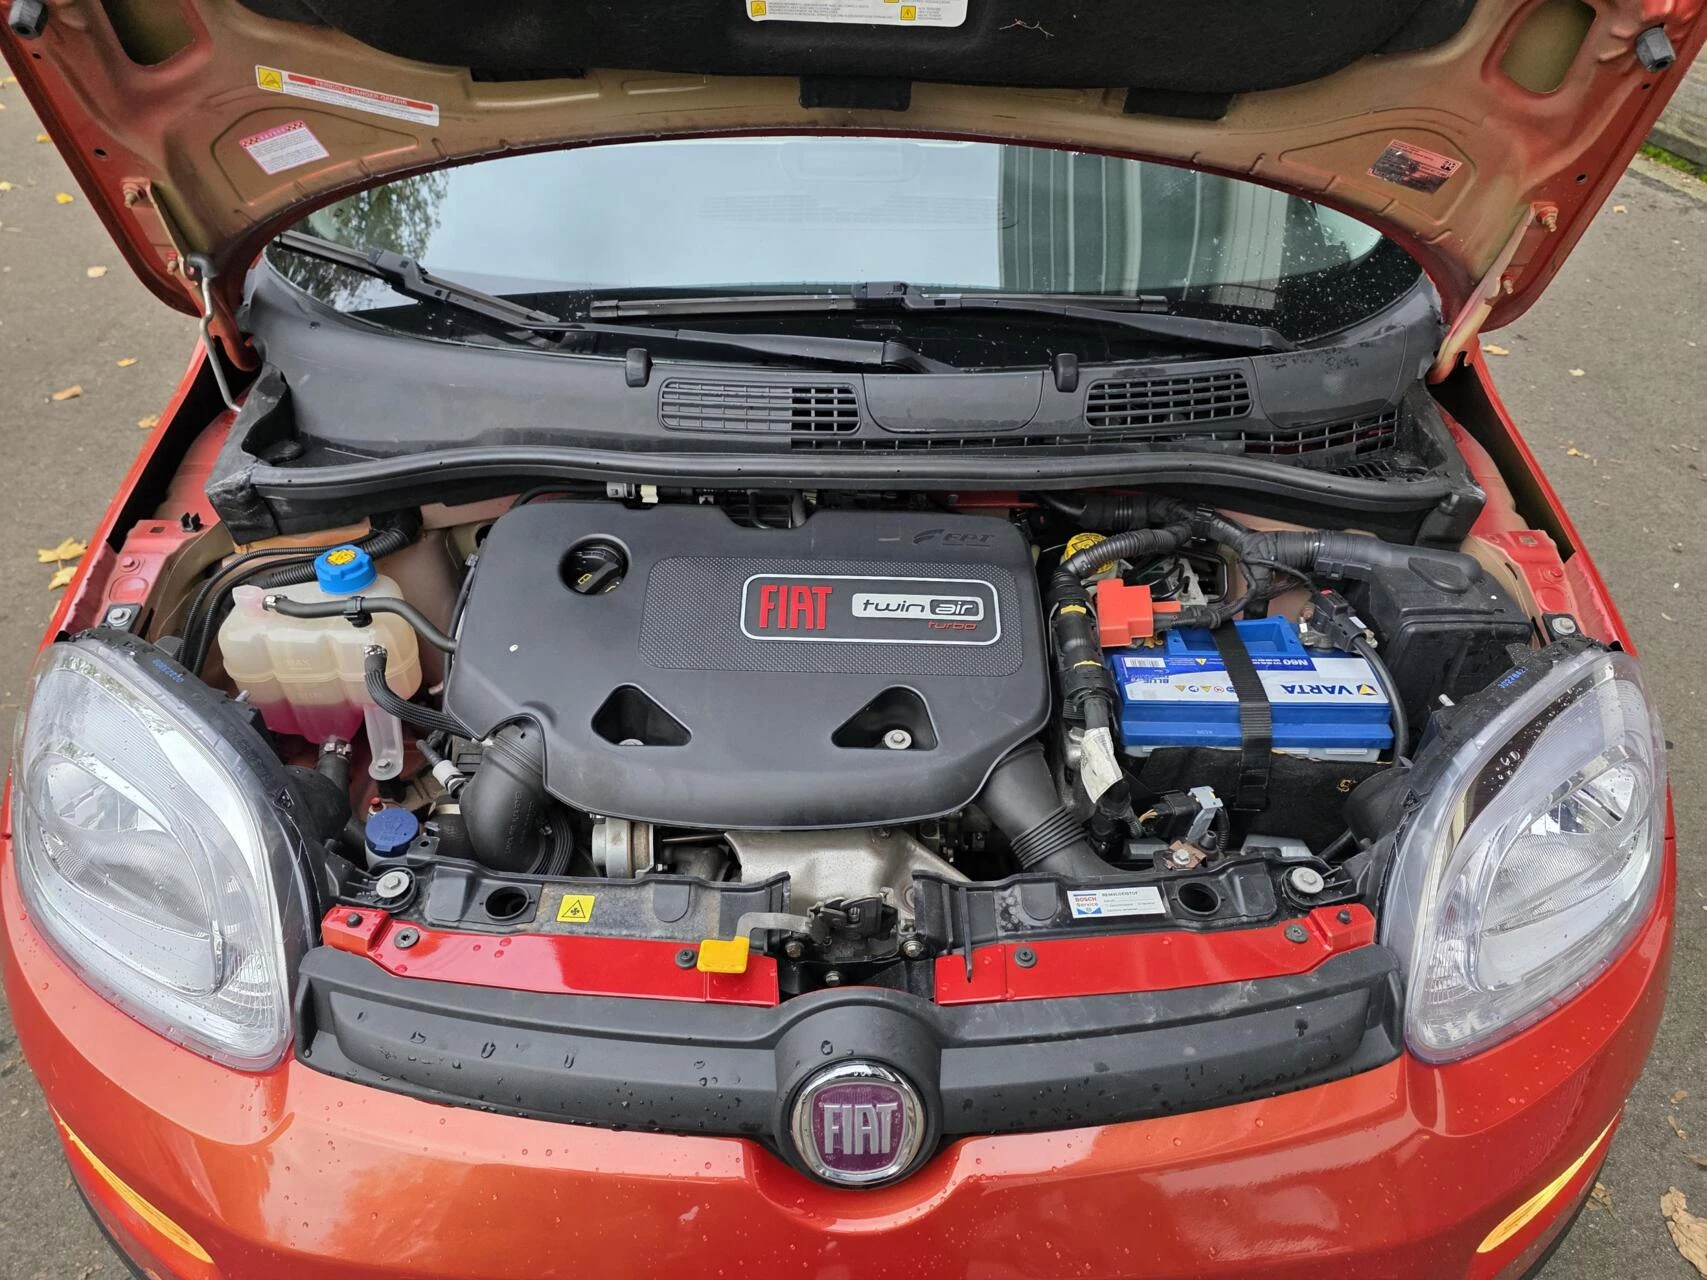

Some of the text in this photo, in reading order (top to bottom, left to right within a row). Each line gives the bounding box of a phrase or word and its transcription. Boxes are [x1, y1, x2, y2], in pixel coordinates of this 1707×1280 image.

[759, 584, 833, 630] FIAT
[863, 599, 974, 615] twin air
[927, 620, 977, 630] turbo
[1282, 658, 1309, 666] N60
[1280, 684, 1355, 695] VARTA
[823, 1101, 898, 1155] FIAT
